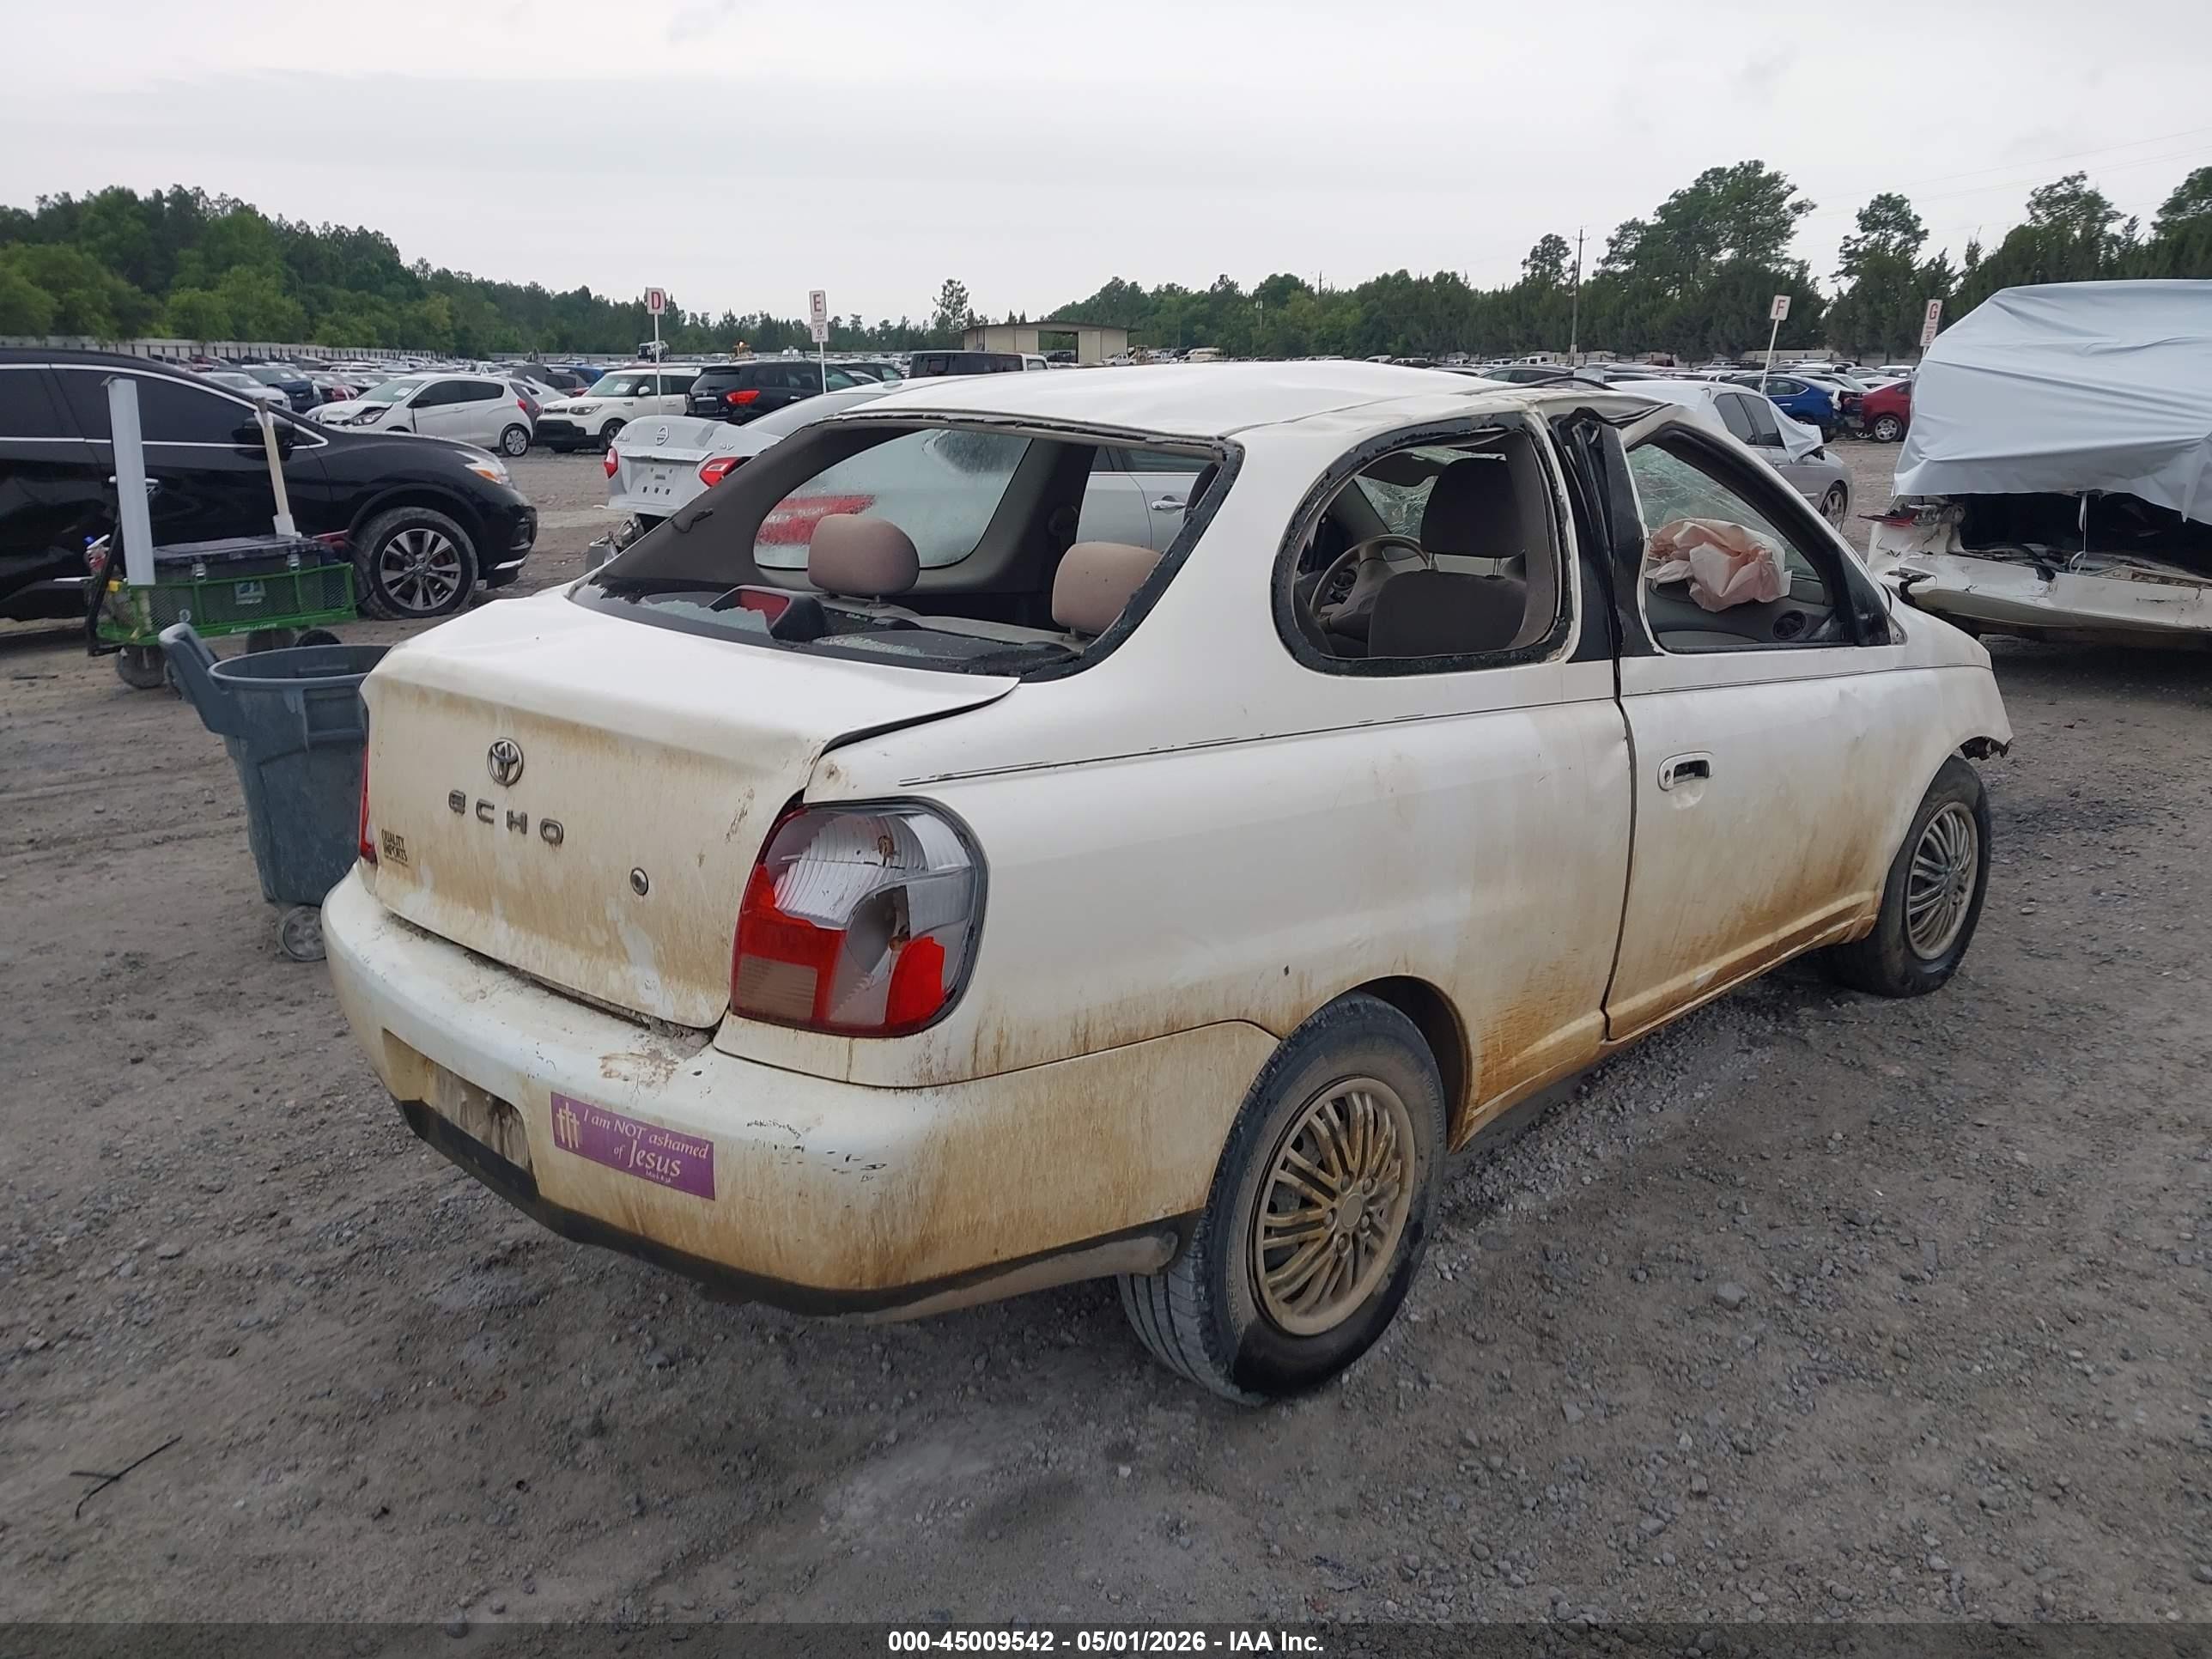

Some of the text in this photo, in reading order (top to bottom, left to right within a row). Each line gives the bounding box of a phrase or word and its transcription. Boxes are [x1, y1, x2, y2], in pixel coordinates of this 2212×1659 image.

[651, 291, 661, 310] D
[812, 294, 823, 313] E
[1775, 299, 1787, 316] F
[1929, 302, 1939, 320] G
[448, 789, 564, 846] ECHO
[381, 829, 404, 849] QUALITY
[584, 1109, 709, 1159] I am NOT ashamed
[613, 1139, 682, 1178] of Jesus
